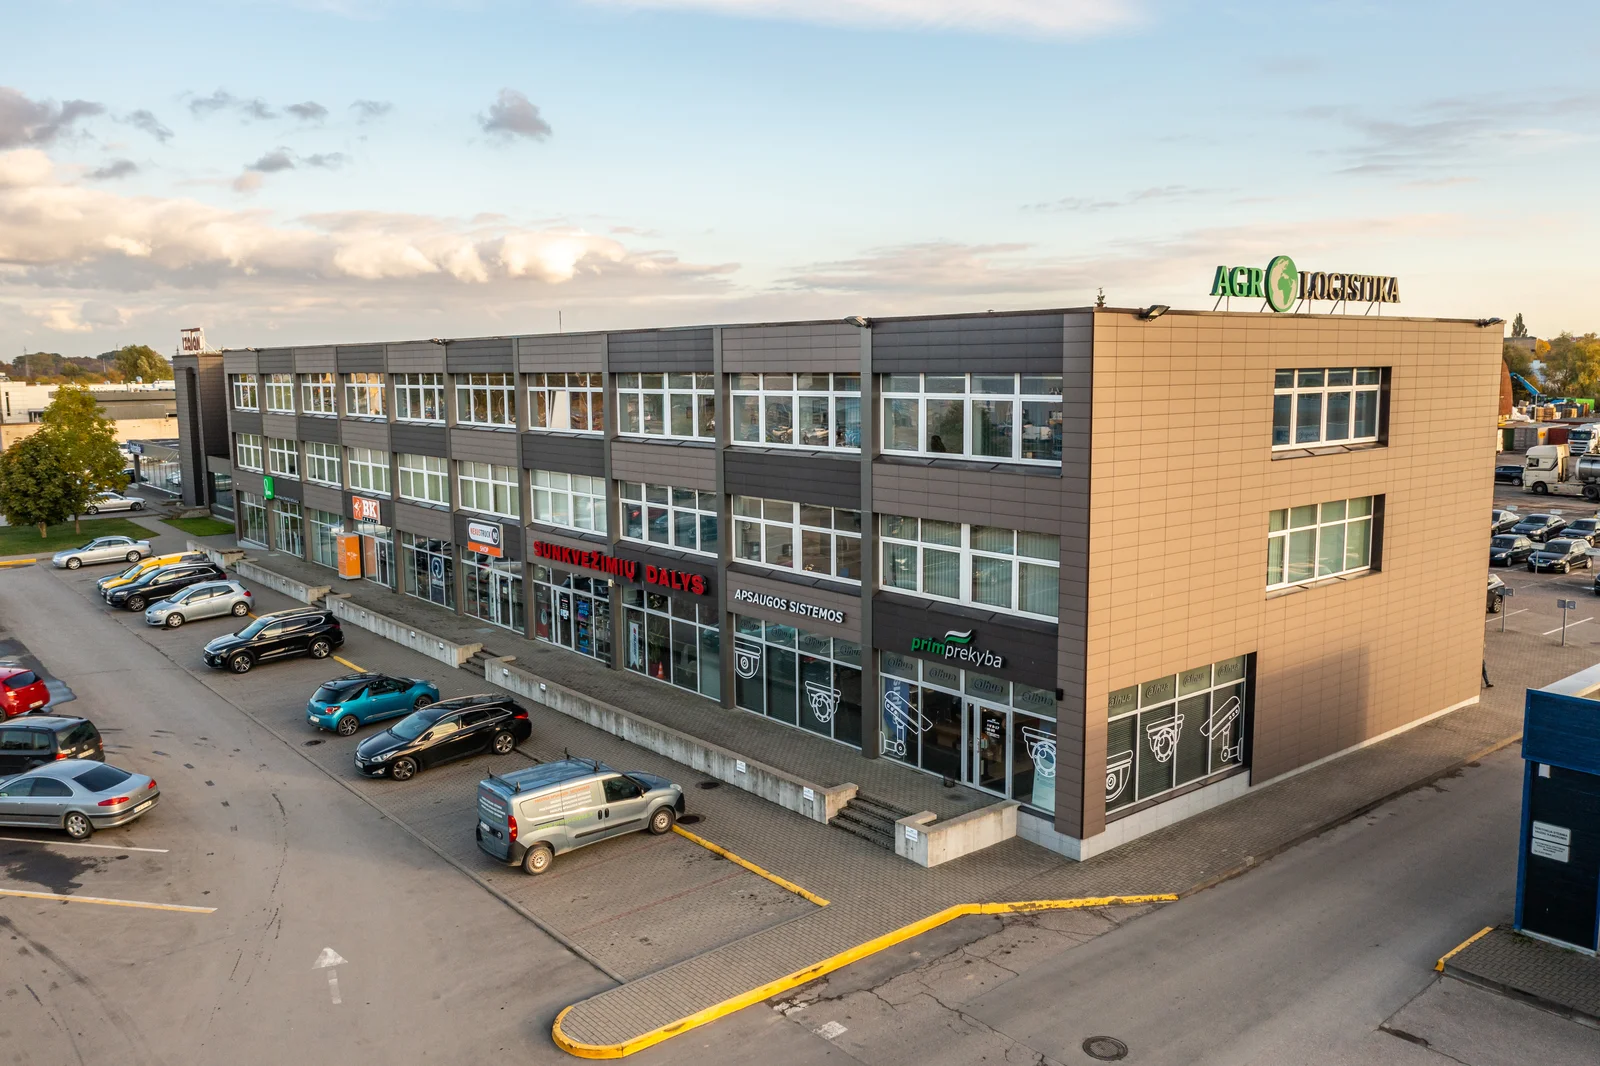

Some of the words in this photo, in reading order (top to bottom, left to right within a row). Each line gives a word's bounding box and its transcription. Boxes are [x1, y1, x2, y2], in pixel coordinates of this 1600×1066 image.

[1298, 270, 1401, 303] LOGISTIKA
[362, 499, 377, 518] BK
[533, 540, 637, 583] SUNKVEŽIMIŲ
[646, 565, 707, 595] DALYS
[734, 588, 788, 612] APSAUGOS
[789, 600, 844, 624] SISTEMOS
[911, 635, 1004, 669] primprekyba
